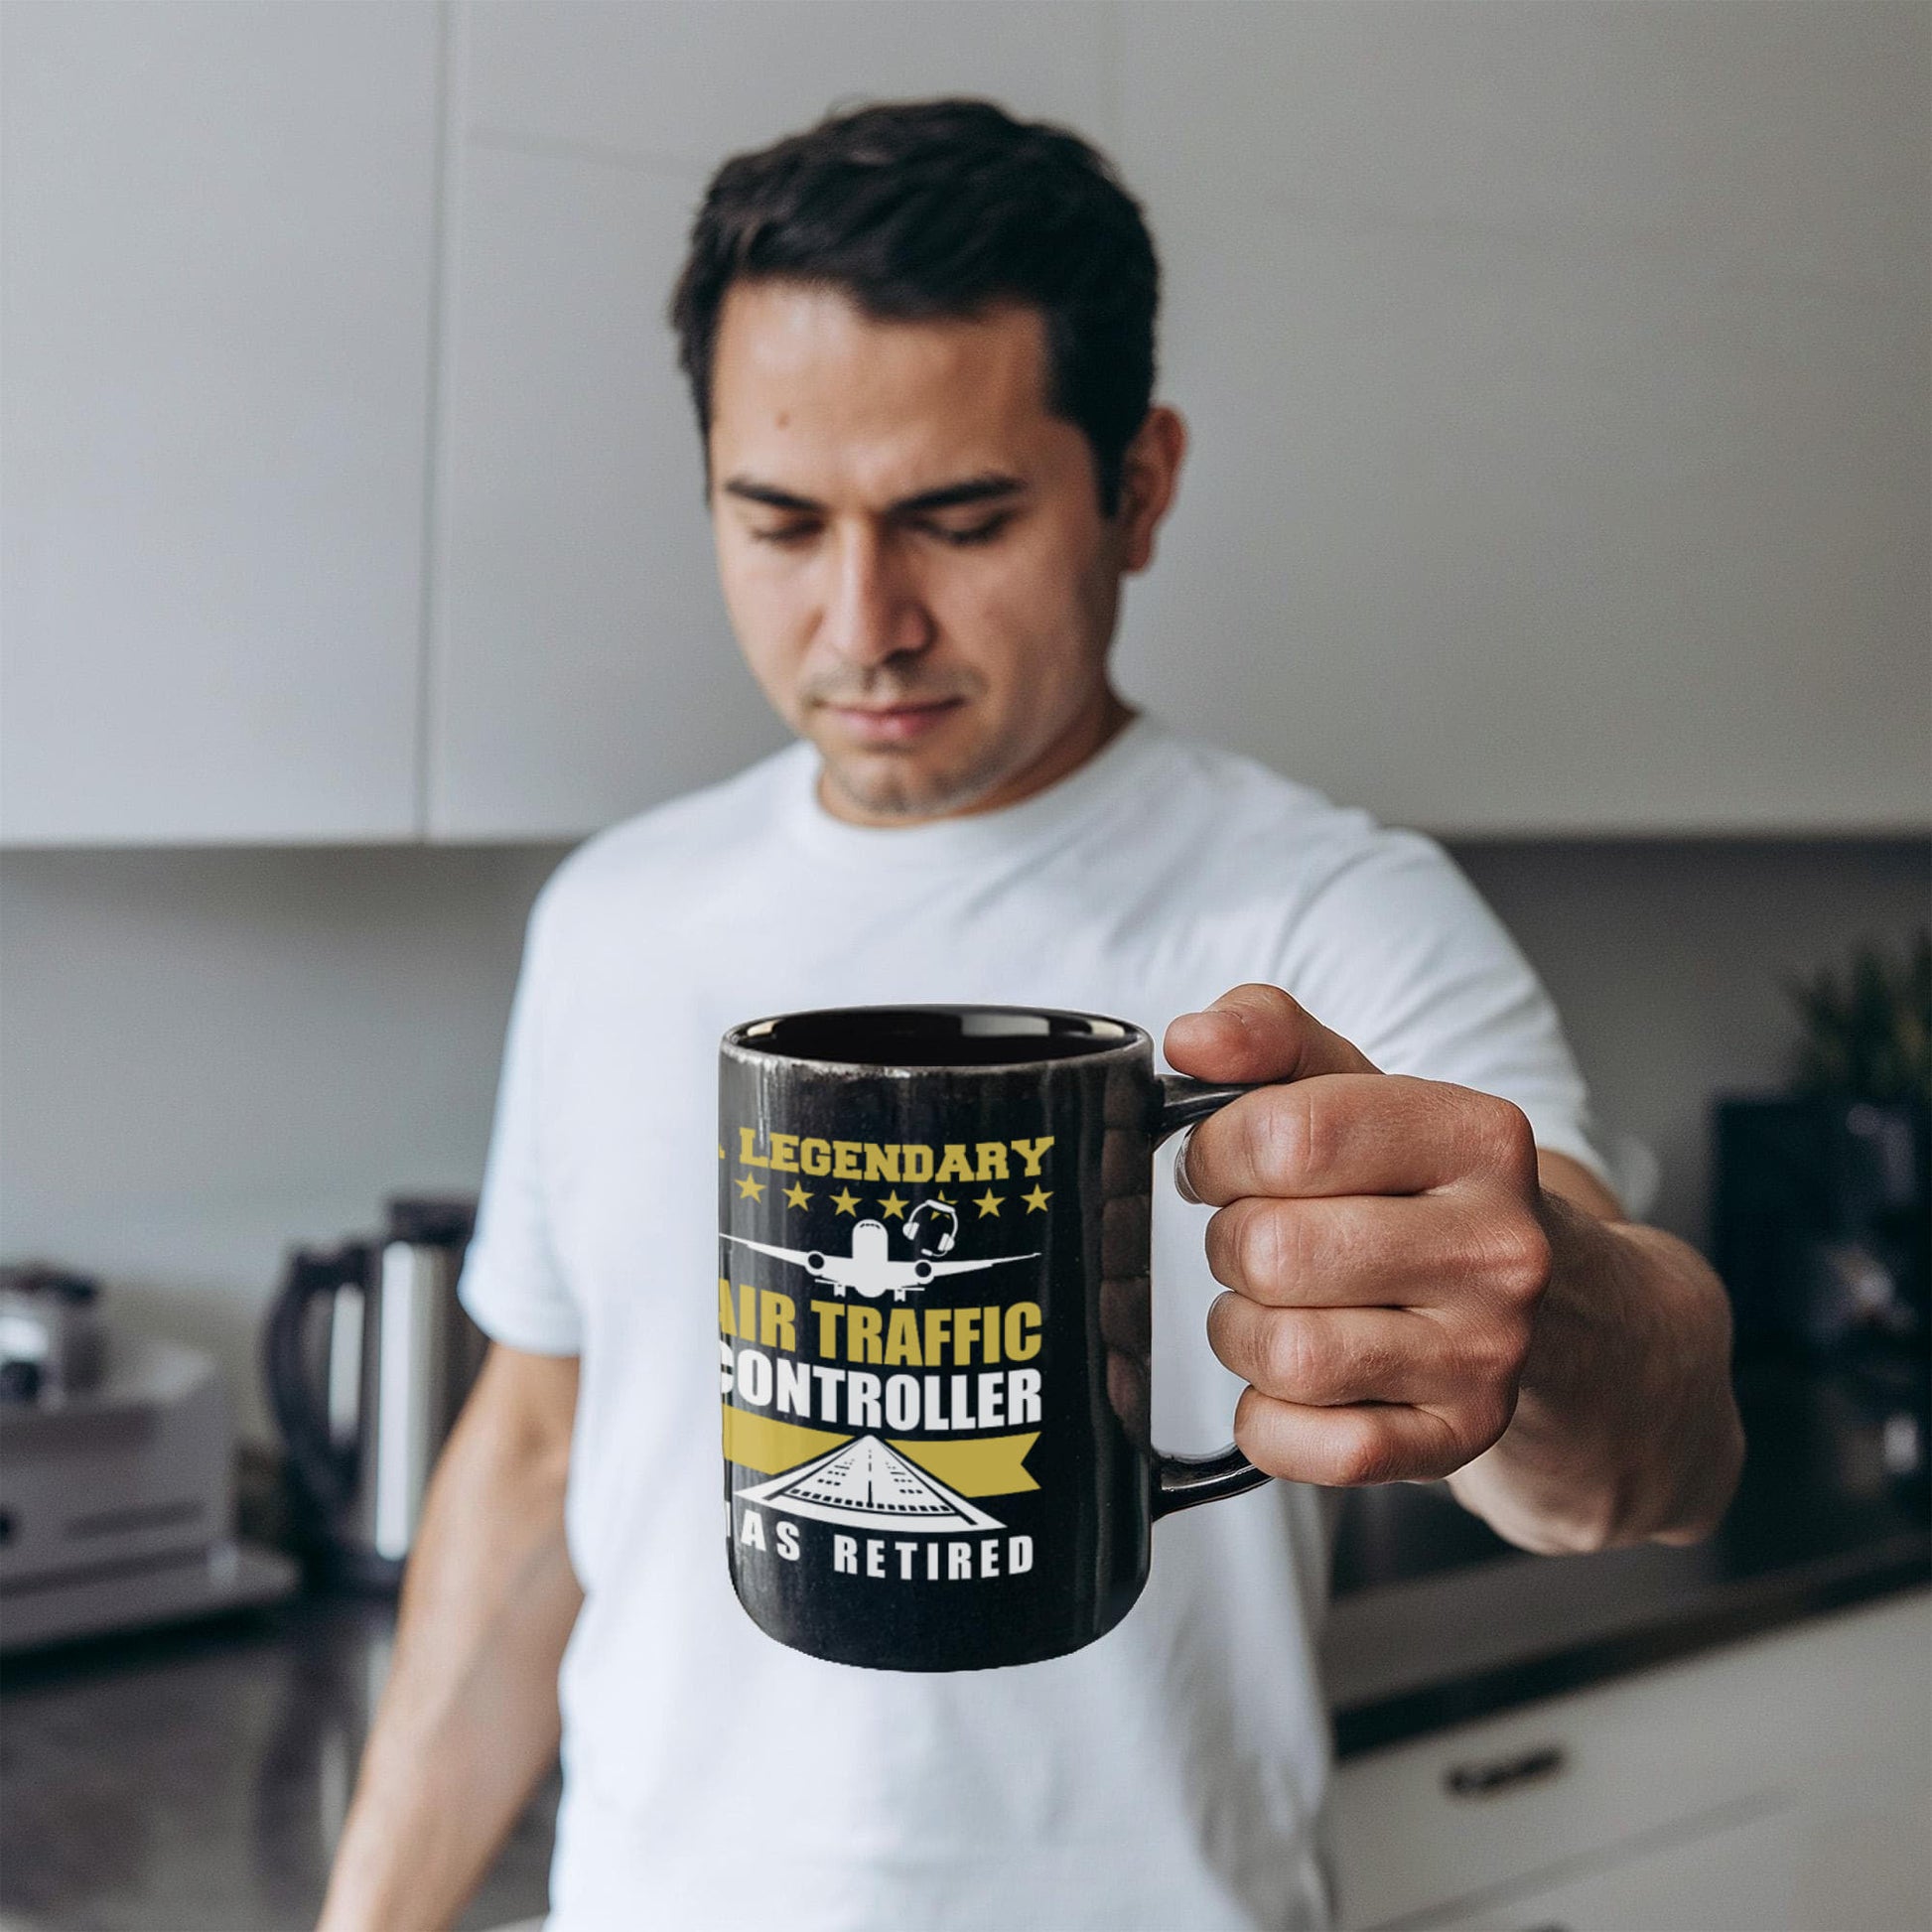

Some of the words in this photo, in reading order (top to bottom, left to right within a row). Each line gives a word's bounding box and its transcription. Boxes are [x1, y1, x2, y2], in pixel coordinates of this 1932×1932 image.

[739, 1127, 1055, 1183] LEGENDARY
[810, 1301, 1042, 1367] TRAFFIC
[726, 1501, 800, 1562] AS
[833, 1535, 1034, 1581] RETIRED
